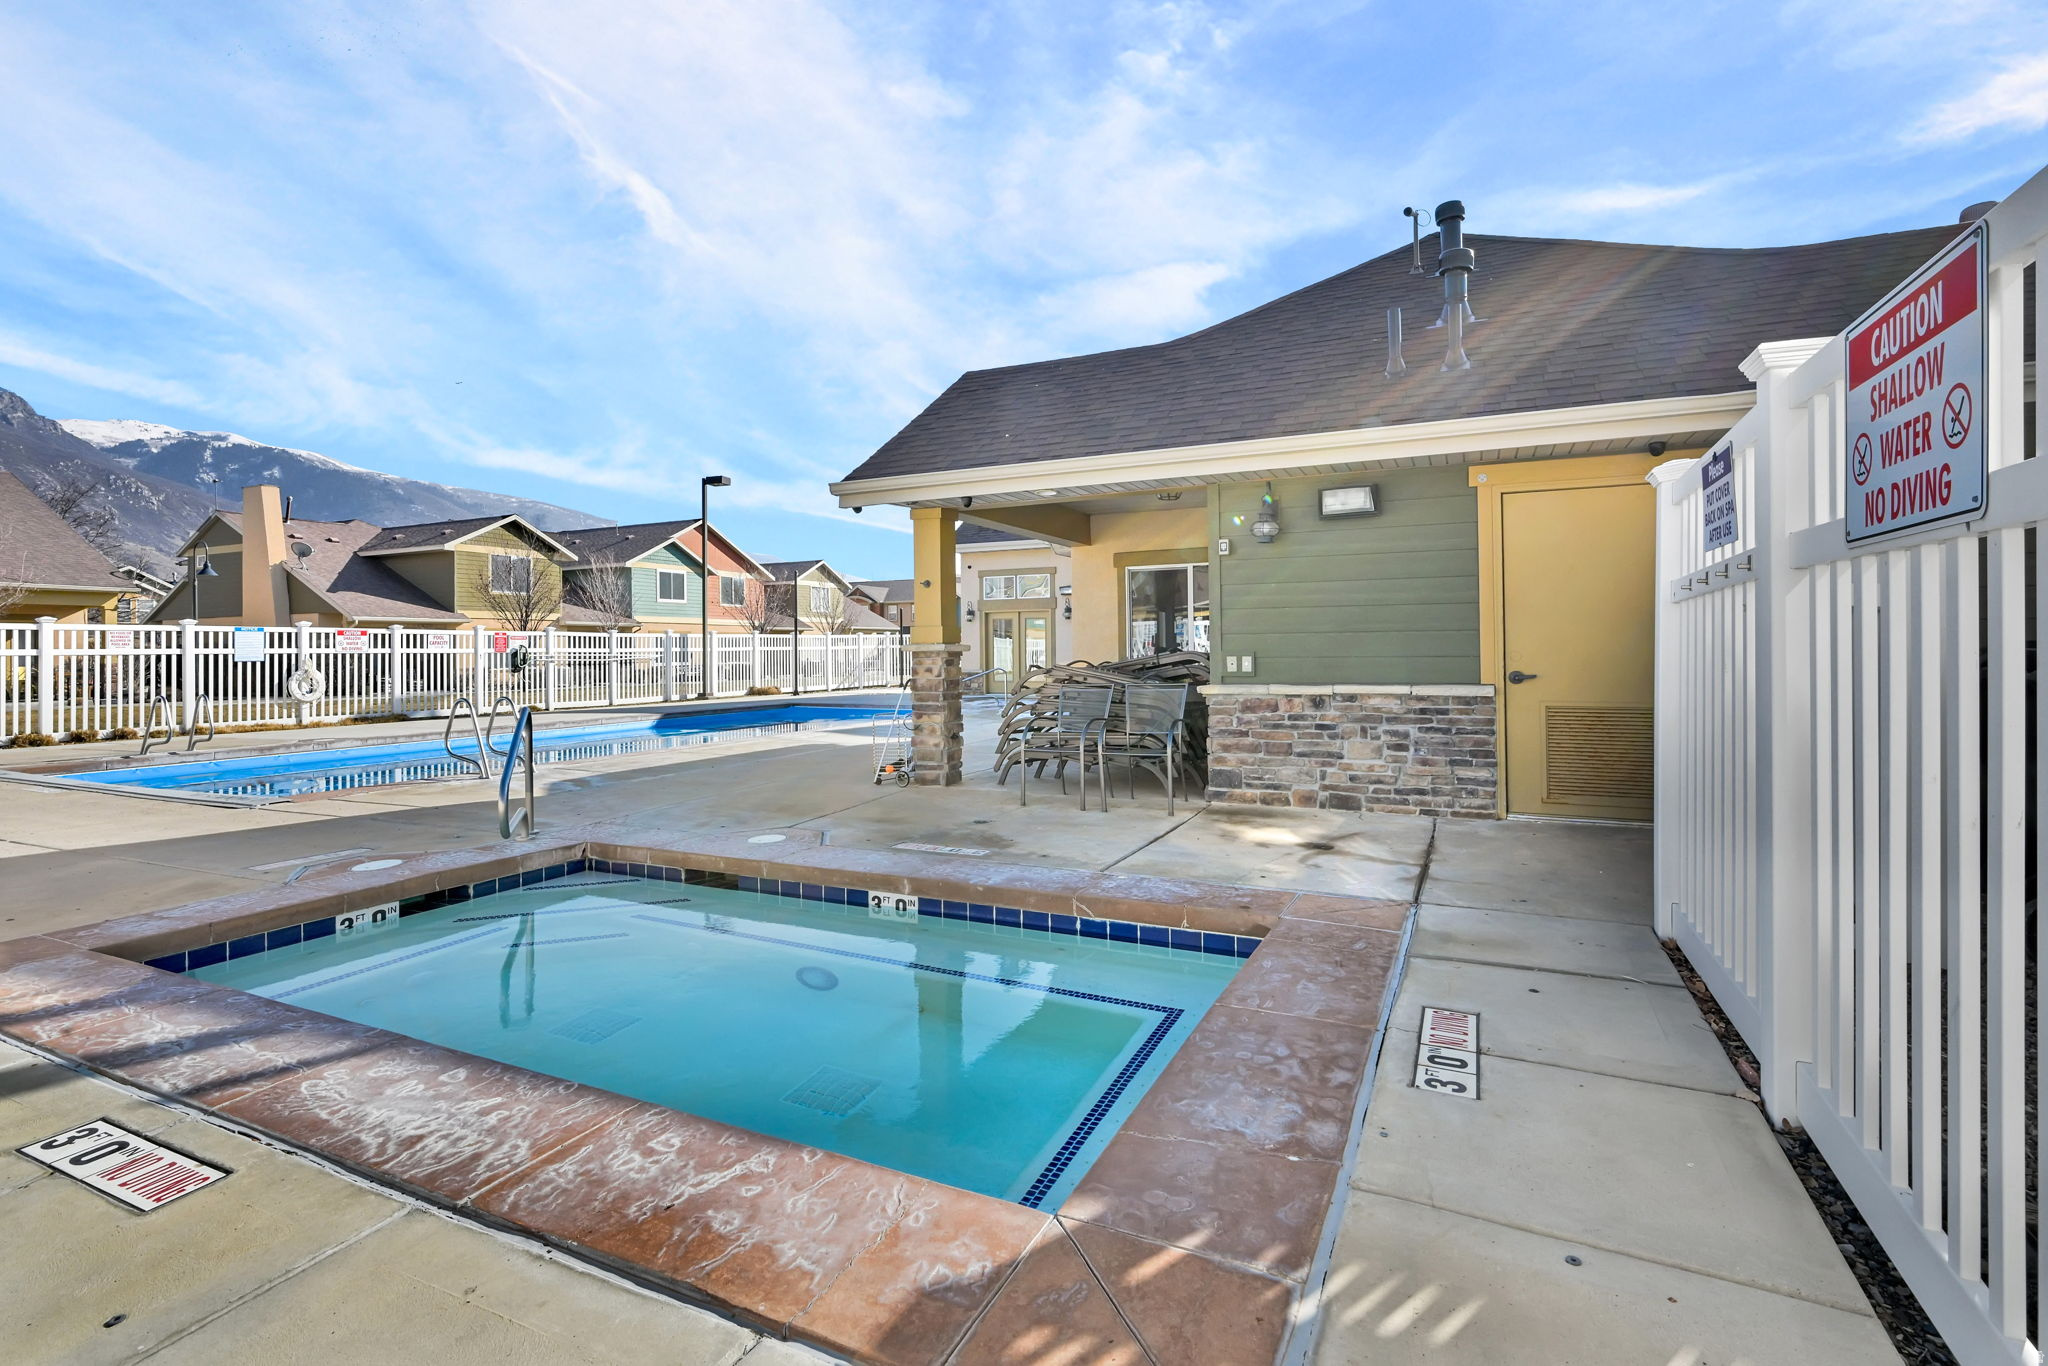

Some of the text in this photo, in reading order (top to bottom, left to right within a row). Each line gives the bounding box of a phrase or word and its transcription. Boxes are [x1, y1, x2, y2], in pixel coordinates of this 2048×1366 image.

[1870, 279, 1944, 367] CAUTION
[1869, 341, 1946, 424] SHALLOW
[1879, 410, 1932, 470] WATER
[1708, 460, 1725, 483] Please
[1706, 481, 1731, 509] PUT COVER
[1864, 462, 1952, 528] NO DIVING
[1704, 499, 1735, 527] BACK ON SPA
[1708, 520, 1732, 544] AFTER USE
[882, 896, 891, 904] FT
[907, 899, 916, 908] IN
[355, 913, 366, 923] FT
[387, 905, 397, 915] IN
[1430, 1010, 1469, 1036] DIVING
[1428, 1033, 1469, 1049] NO
[1428, 1046, 1442, 1055] IN
[1425, 1068, 1440, 1078] FT
[1424, 1077, 1467, 1093] 3
[40, 1127, 99, 1150] 3
[87, 1131, 114, 1143] FT
[119, 1145, 145, 1158] IN
[96, 1152, 165, 1182] NO
[117, 1161, 212, 1203] DIVING
